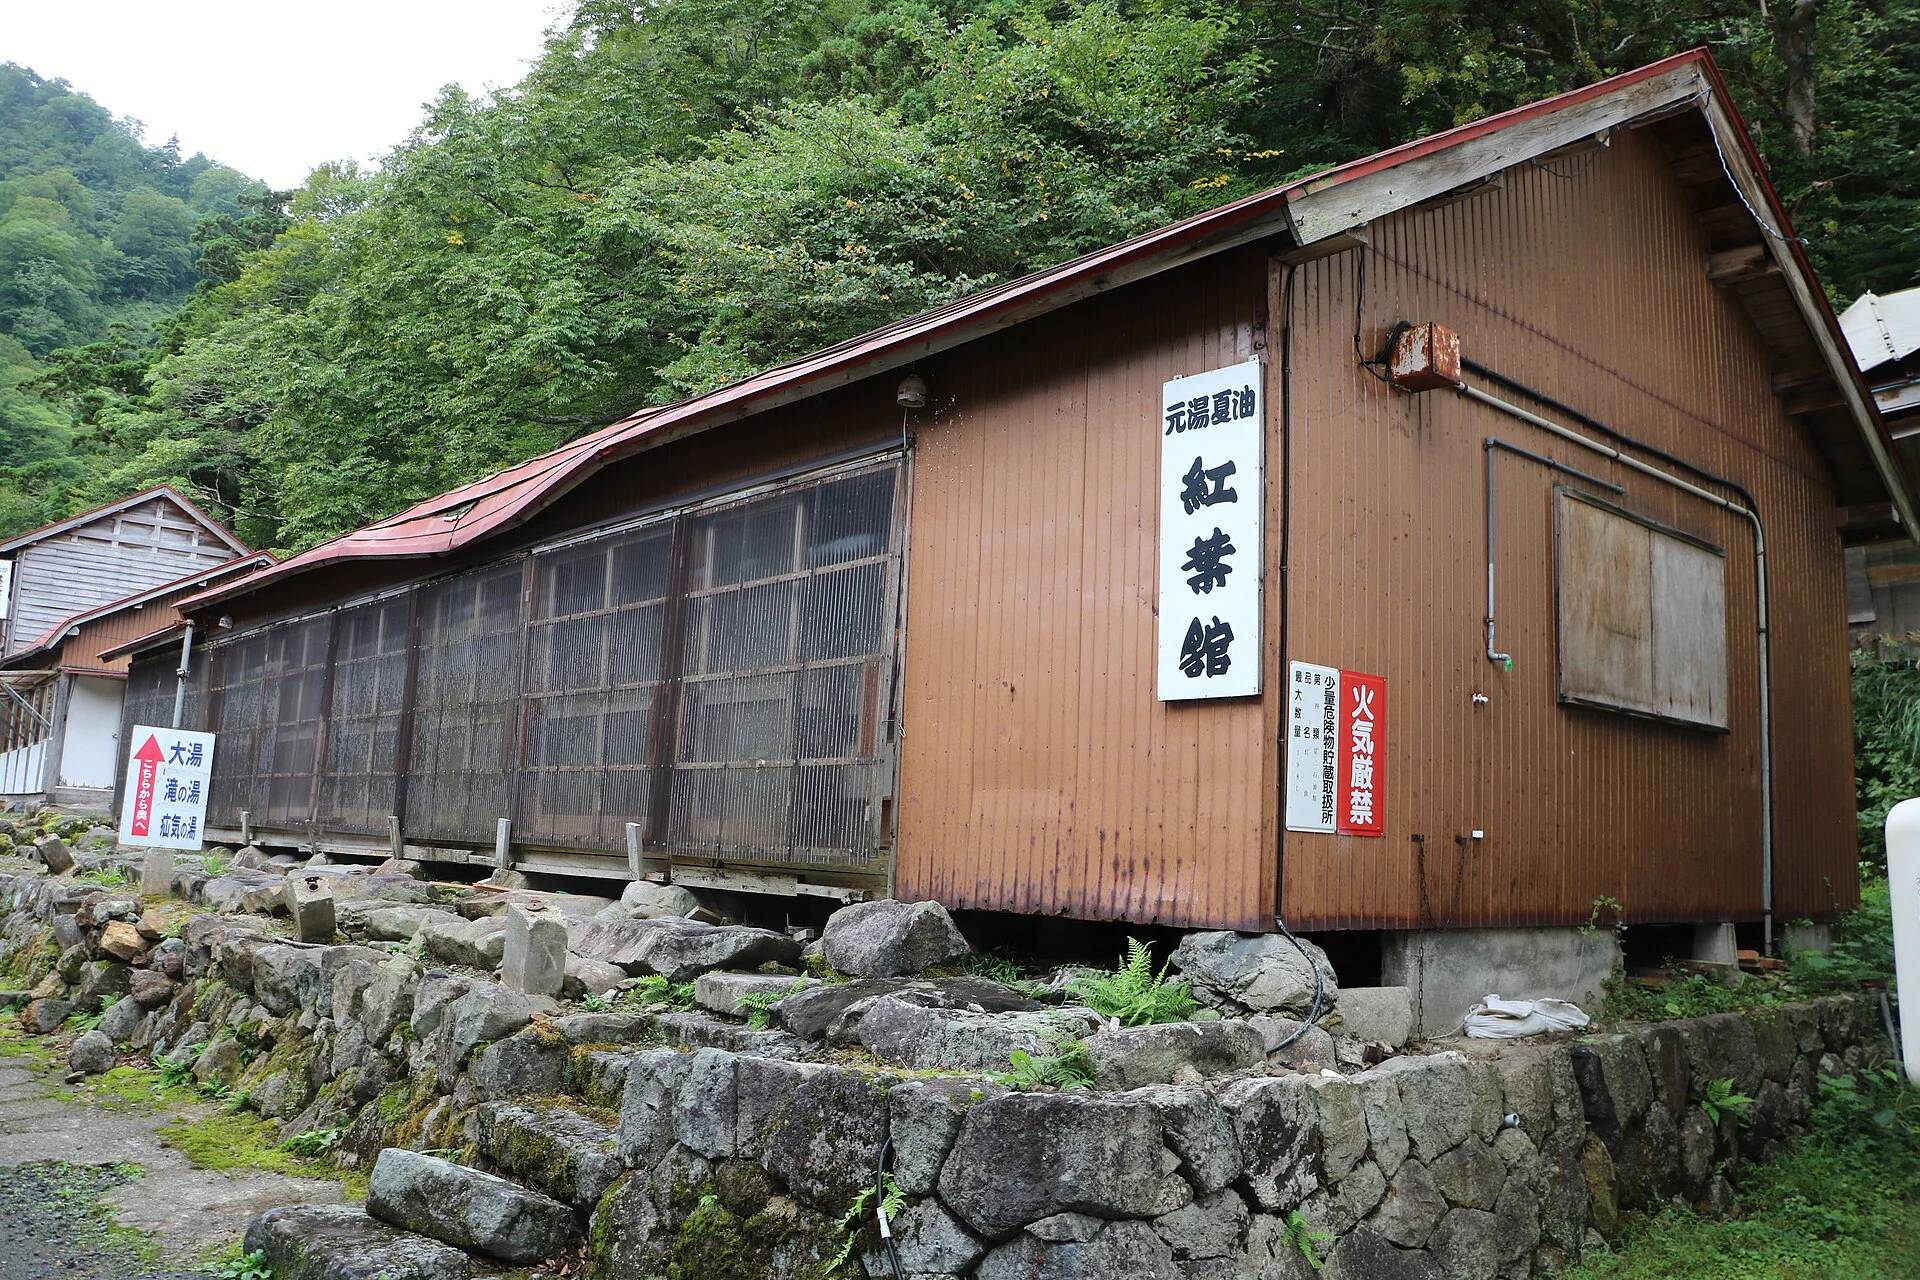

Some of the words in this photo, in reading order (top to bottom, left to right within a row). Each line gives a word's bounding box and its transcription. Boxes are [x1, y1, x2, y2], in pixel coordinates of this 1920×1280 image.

[1165, 384, 1256, 436] 元湯夏油
[168, 741, 204, 768] 大湯
[1321, 675, 1336, 825] 少量危険物貯蔵取扱所
[1349, 684, 1375, 825] 火気厳禁
[135, 759, 153, 830] こちらから奥へ
[163, 777, 201, 805] 滝の湯
